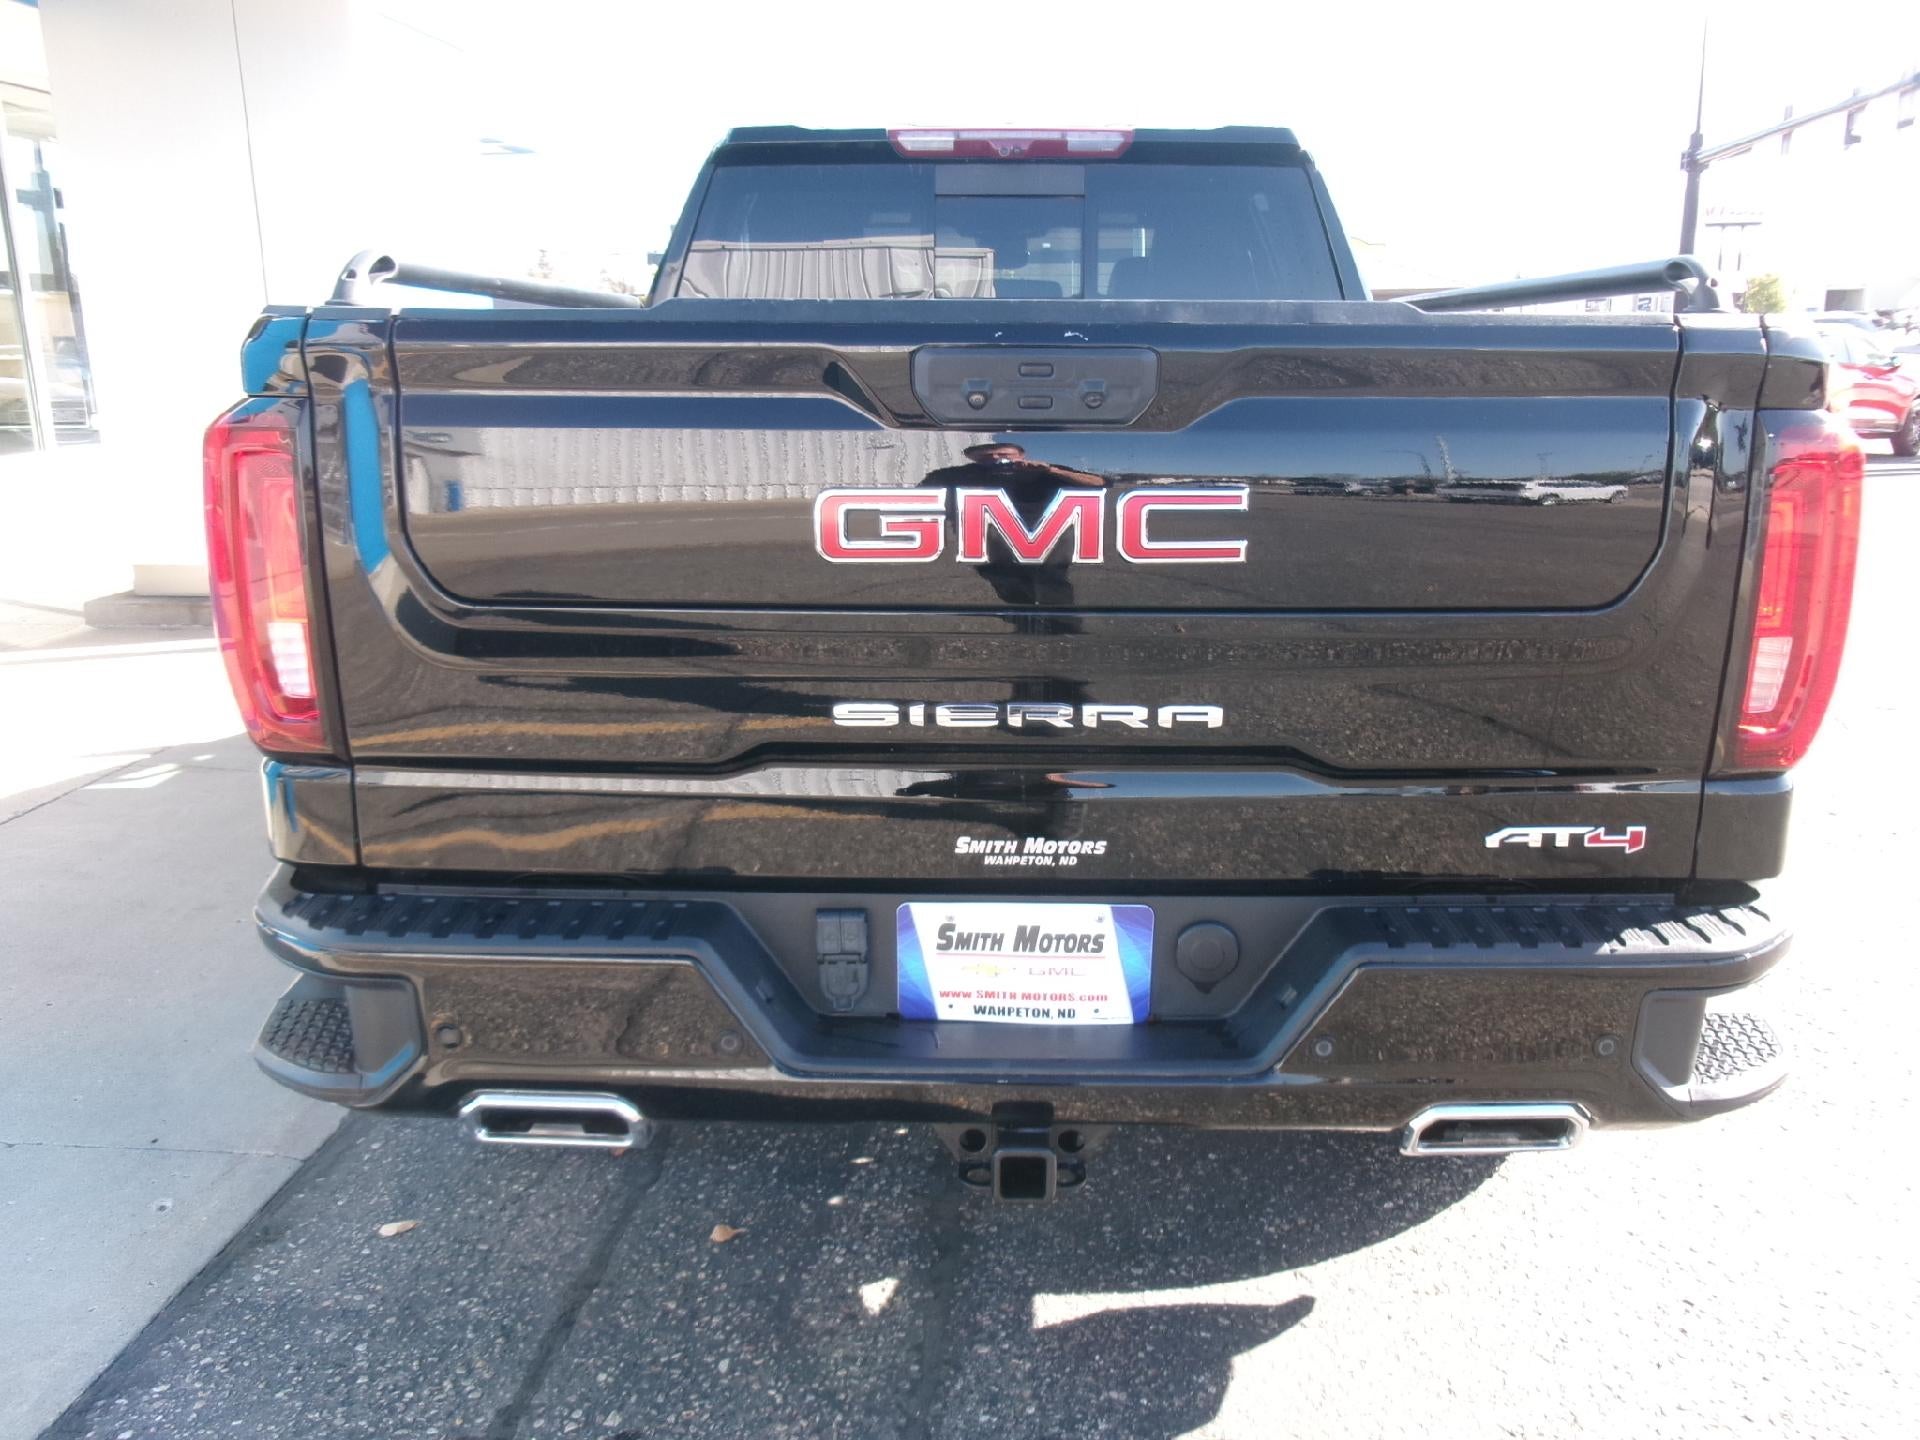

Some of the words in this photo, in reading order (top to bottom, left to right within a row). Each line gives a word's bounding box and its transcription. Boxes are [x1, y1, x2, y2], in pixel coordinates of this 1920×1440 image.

[814, 487, 1249, 564] GMC
[831, 702, 1225, 729] SIERRA
[955, 837, 1017, 854] SMITH
[1022, 838, 1107, 855] MOTORS
[1485, 826, 1646, 854] AT4
[984, 856, 1055, 867] WAHPETON,
[1058, 857, 1077, 866] ND
[936, 923, 1004, 951] SMITH
[1012, 924, 1106, 954] MOTORS
[973, 1004, 1054, 1020] WAHPETON,
[1057, 1008, 1076, 1019] ND
